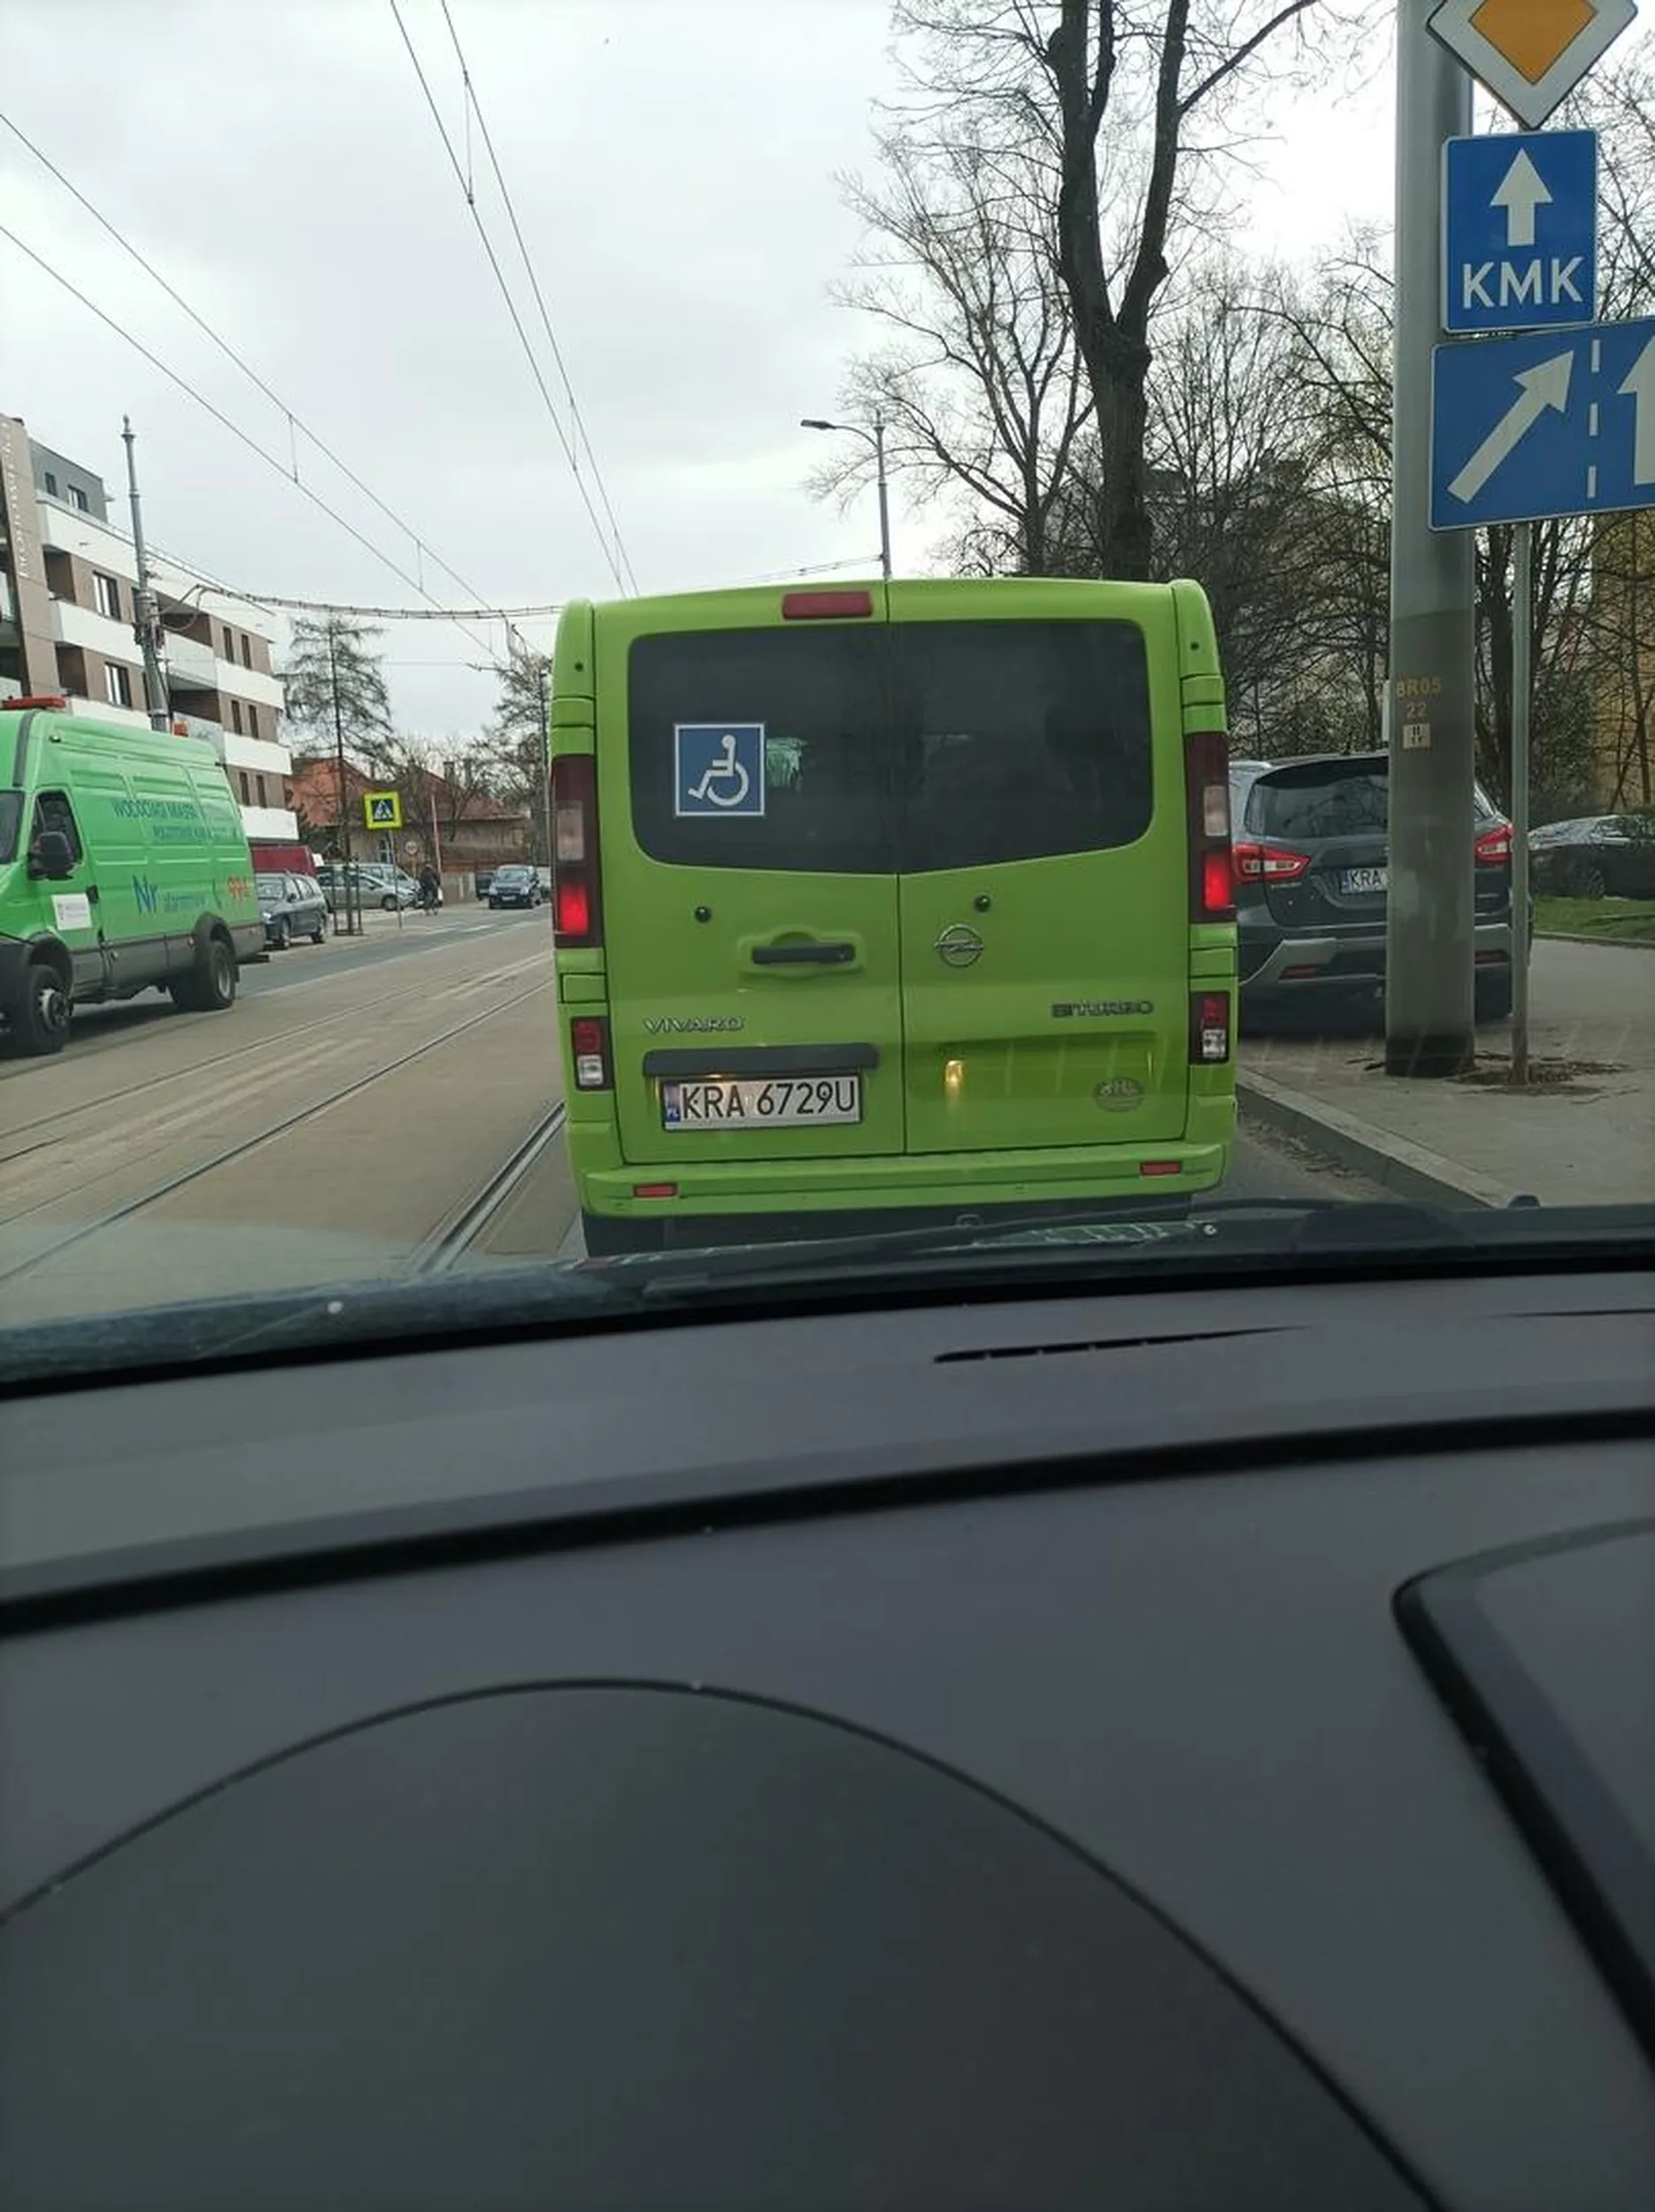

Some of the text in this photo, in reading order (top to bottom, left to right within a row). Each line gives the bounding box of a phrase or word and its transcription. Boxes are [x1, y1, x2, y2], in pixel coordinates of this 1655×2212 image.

[1462, 257, 1583, 309] KMK
[133, 874, 158, 914] Nr
[1350, 870, 1382, 887] KRA
[643, 1016, 745, 1034] VIVARO
[681, 1080, 855, 1119] KRA 6729U
